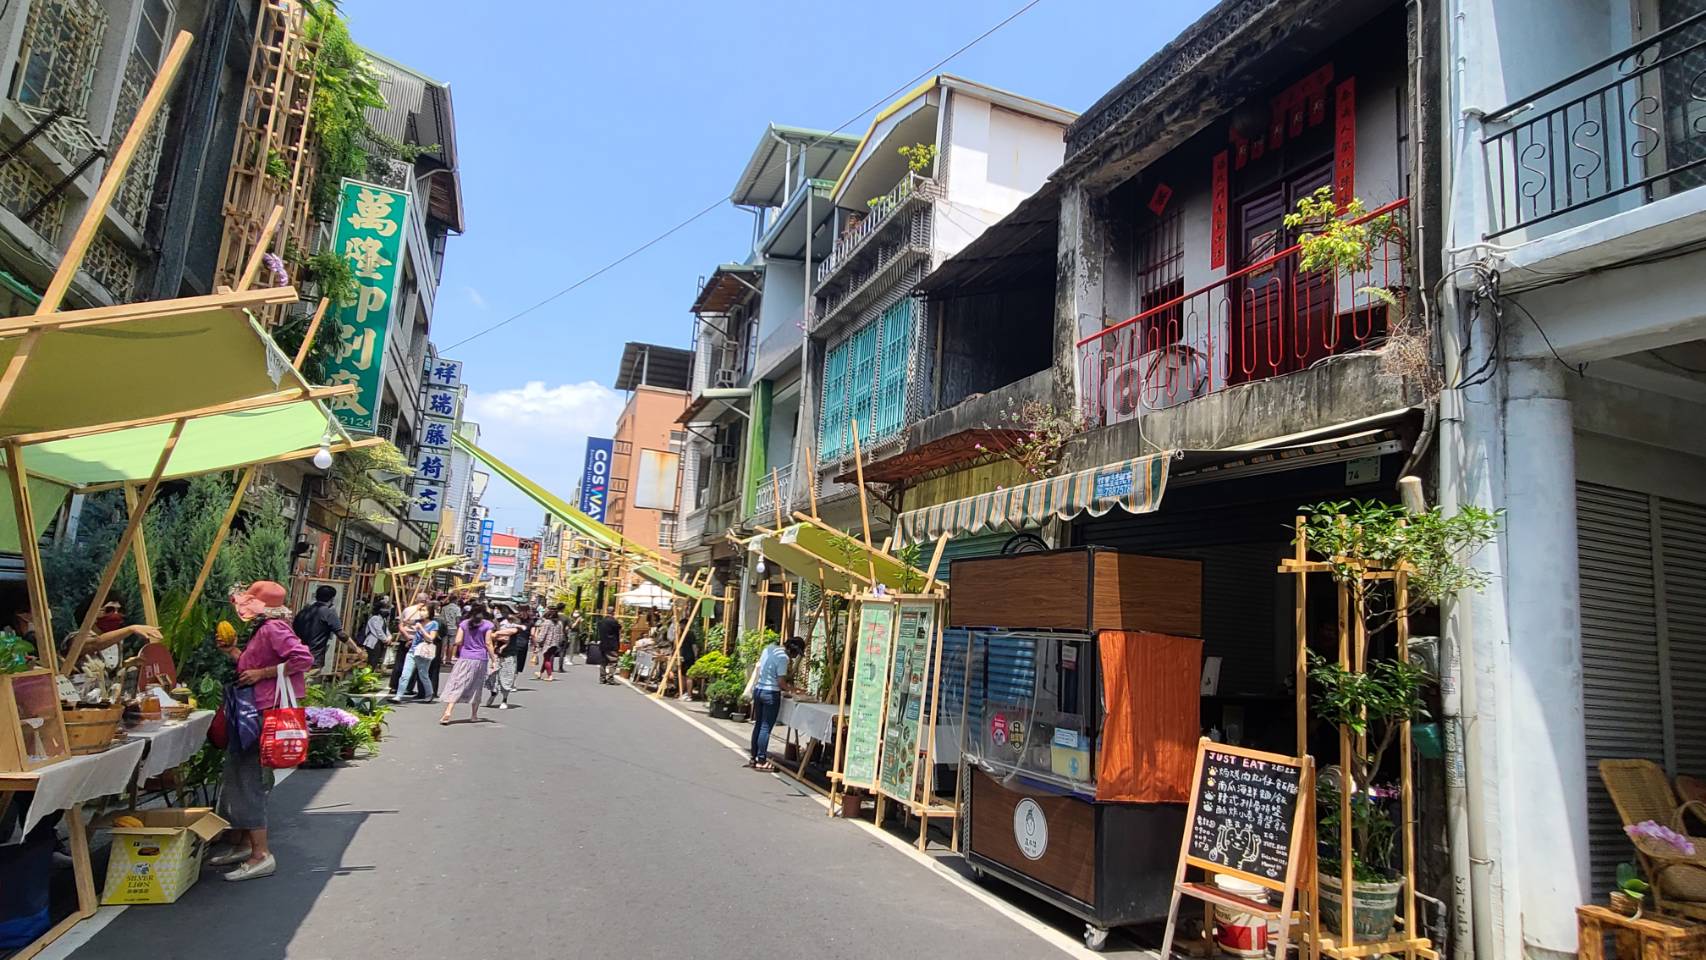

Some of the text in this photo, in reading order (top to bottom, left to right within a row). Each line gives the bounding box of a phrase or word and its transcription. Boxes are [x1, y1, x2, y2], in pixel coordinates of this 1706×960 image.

[336, 415, 372, 427] 2124
[1209, 752, 1237, 764] JUST
[1242, 759, 1266, 771] EAT
